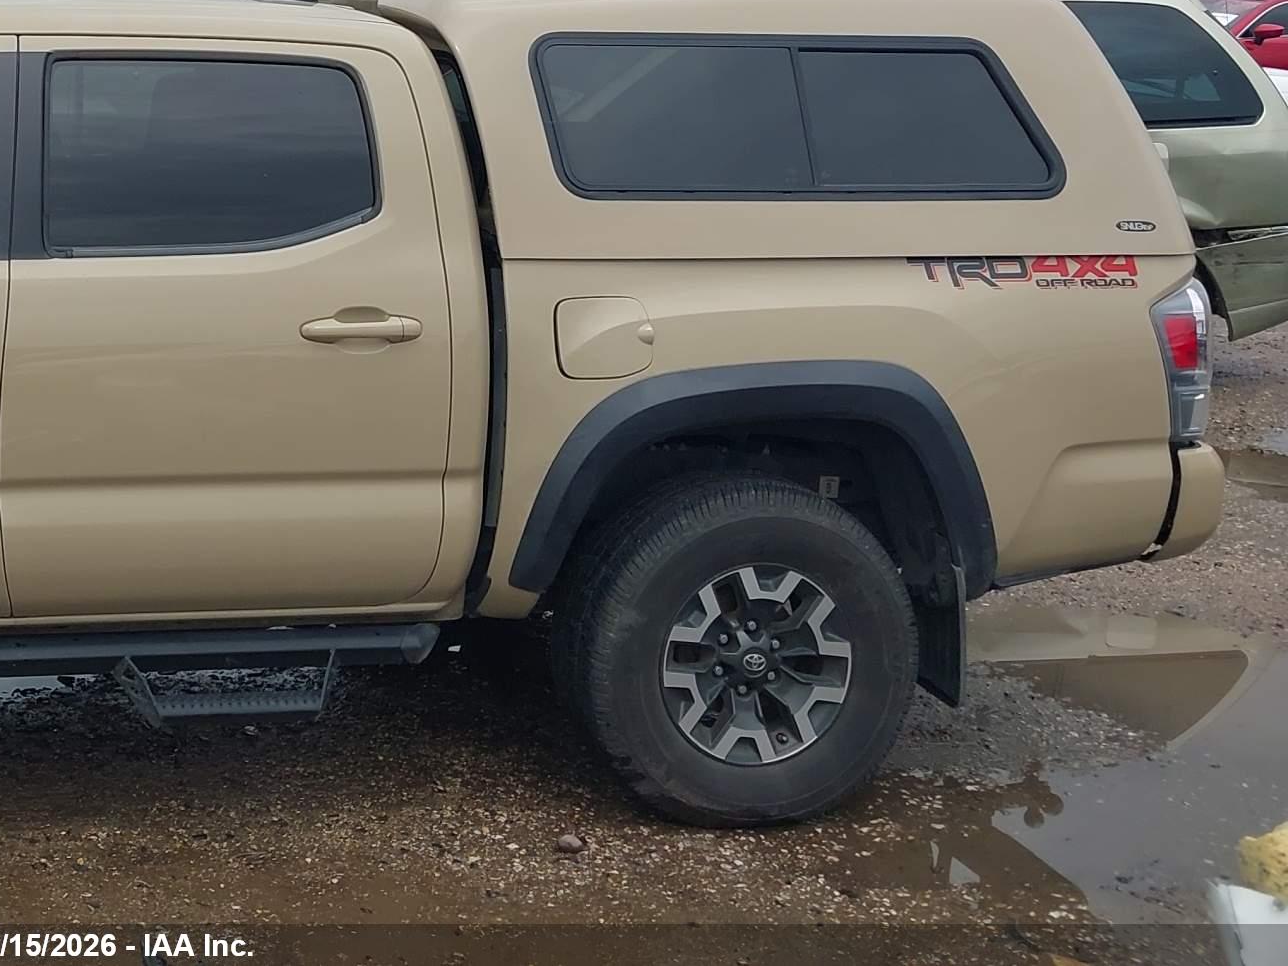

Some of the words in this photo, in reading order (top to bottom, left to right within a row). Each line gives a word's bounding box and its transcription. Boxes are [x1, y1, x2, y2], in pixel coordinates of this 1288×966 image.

[906, 255, 1032, 289] TRD
[1035, 278, 1076, 289] OFF
[1079, 278, 1138, 289] ROAD
